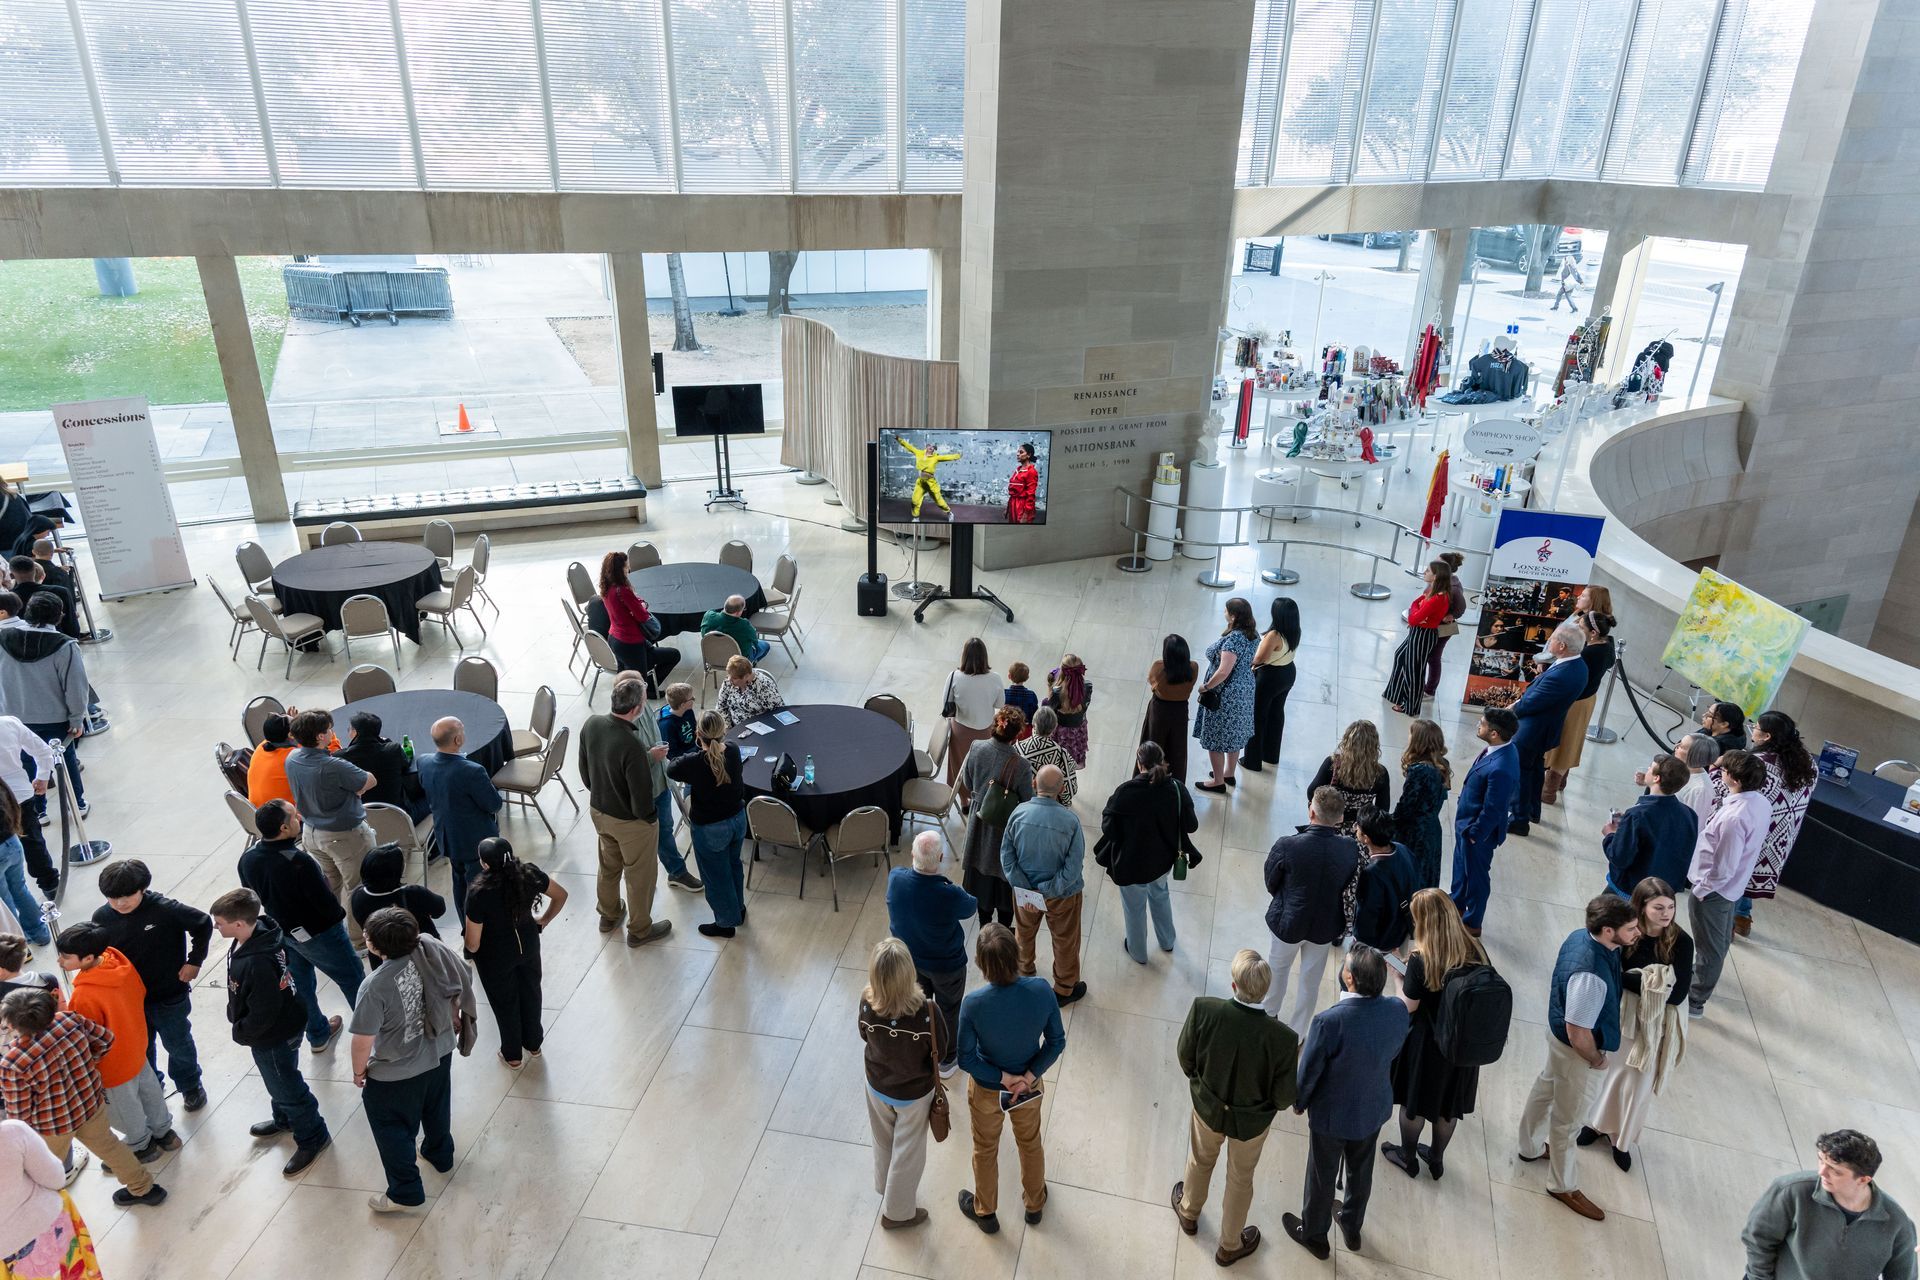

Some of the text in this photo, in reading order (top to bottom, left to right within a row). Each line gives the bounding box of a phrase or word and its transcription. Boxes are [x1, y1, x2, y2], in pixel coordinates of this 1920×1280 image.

[1099, 372, 1116, 381] THE
[1073, 388, 1138, 400] RENAISSANCE
[1090, 406, 1118, 416] FOYER
[62, 412, 146, 429] Concessions
[1060, 426, 1095, 436] POSSIBLE
[1118, 422, 1143, 431] GRANT
[1146, 420, 1168, 428] FROM
[1471, 430, 1536, 442] SYMPHONY SHOP
[1064, 440, 1137, 454] NATIONSBANK
[1068, 460, 1096, 470] MARCH
[1512, 562, 1569, 575] LONE STAR
